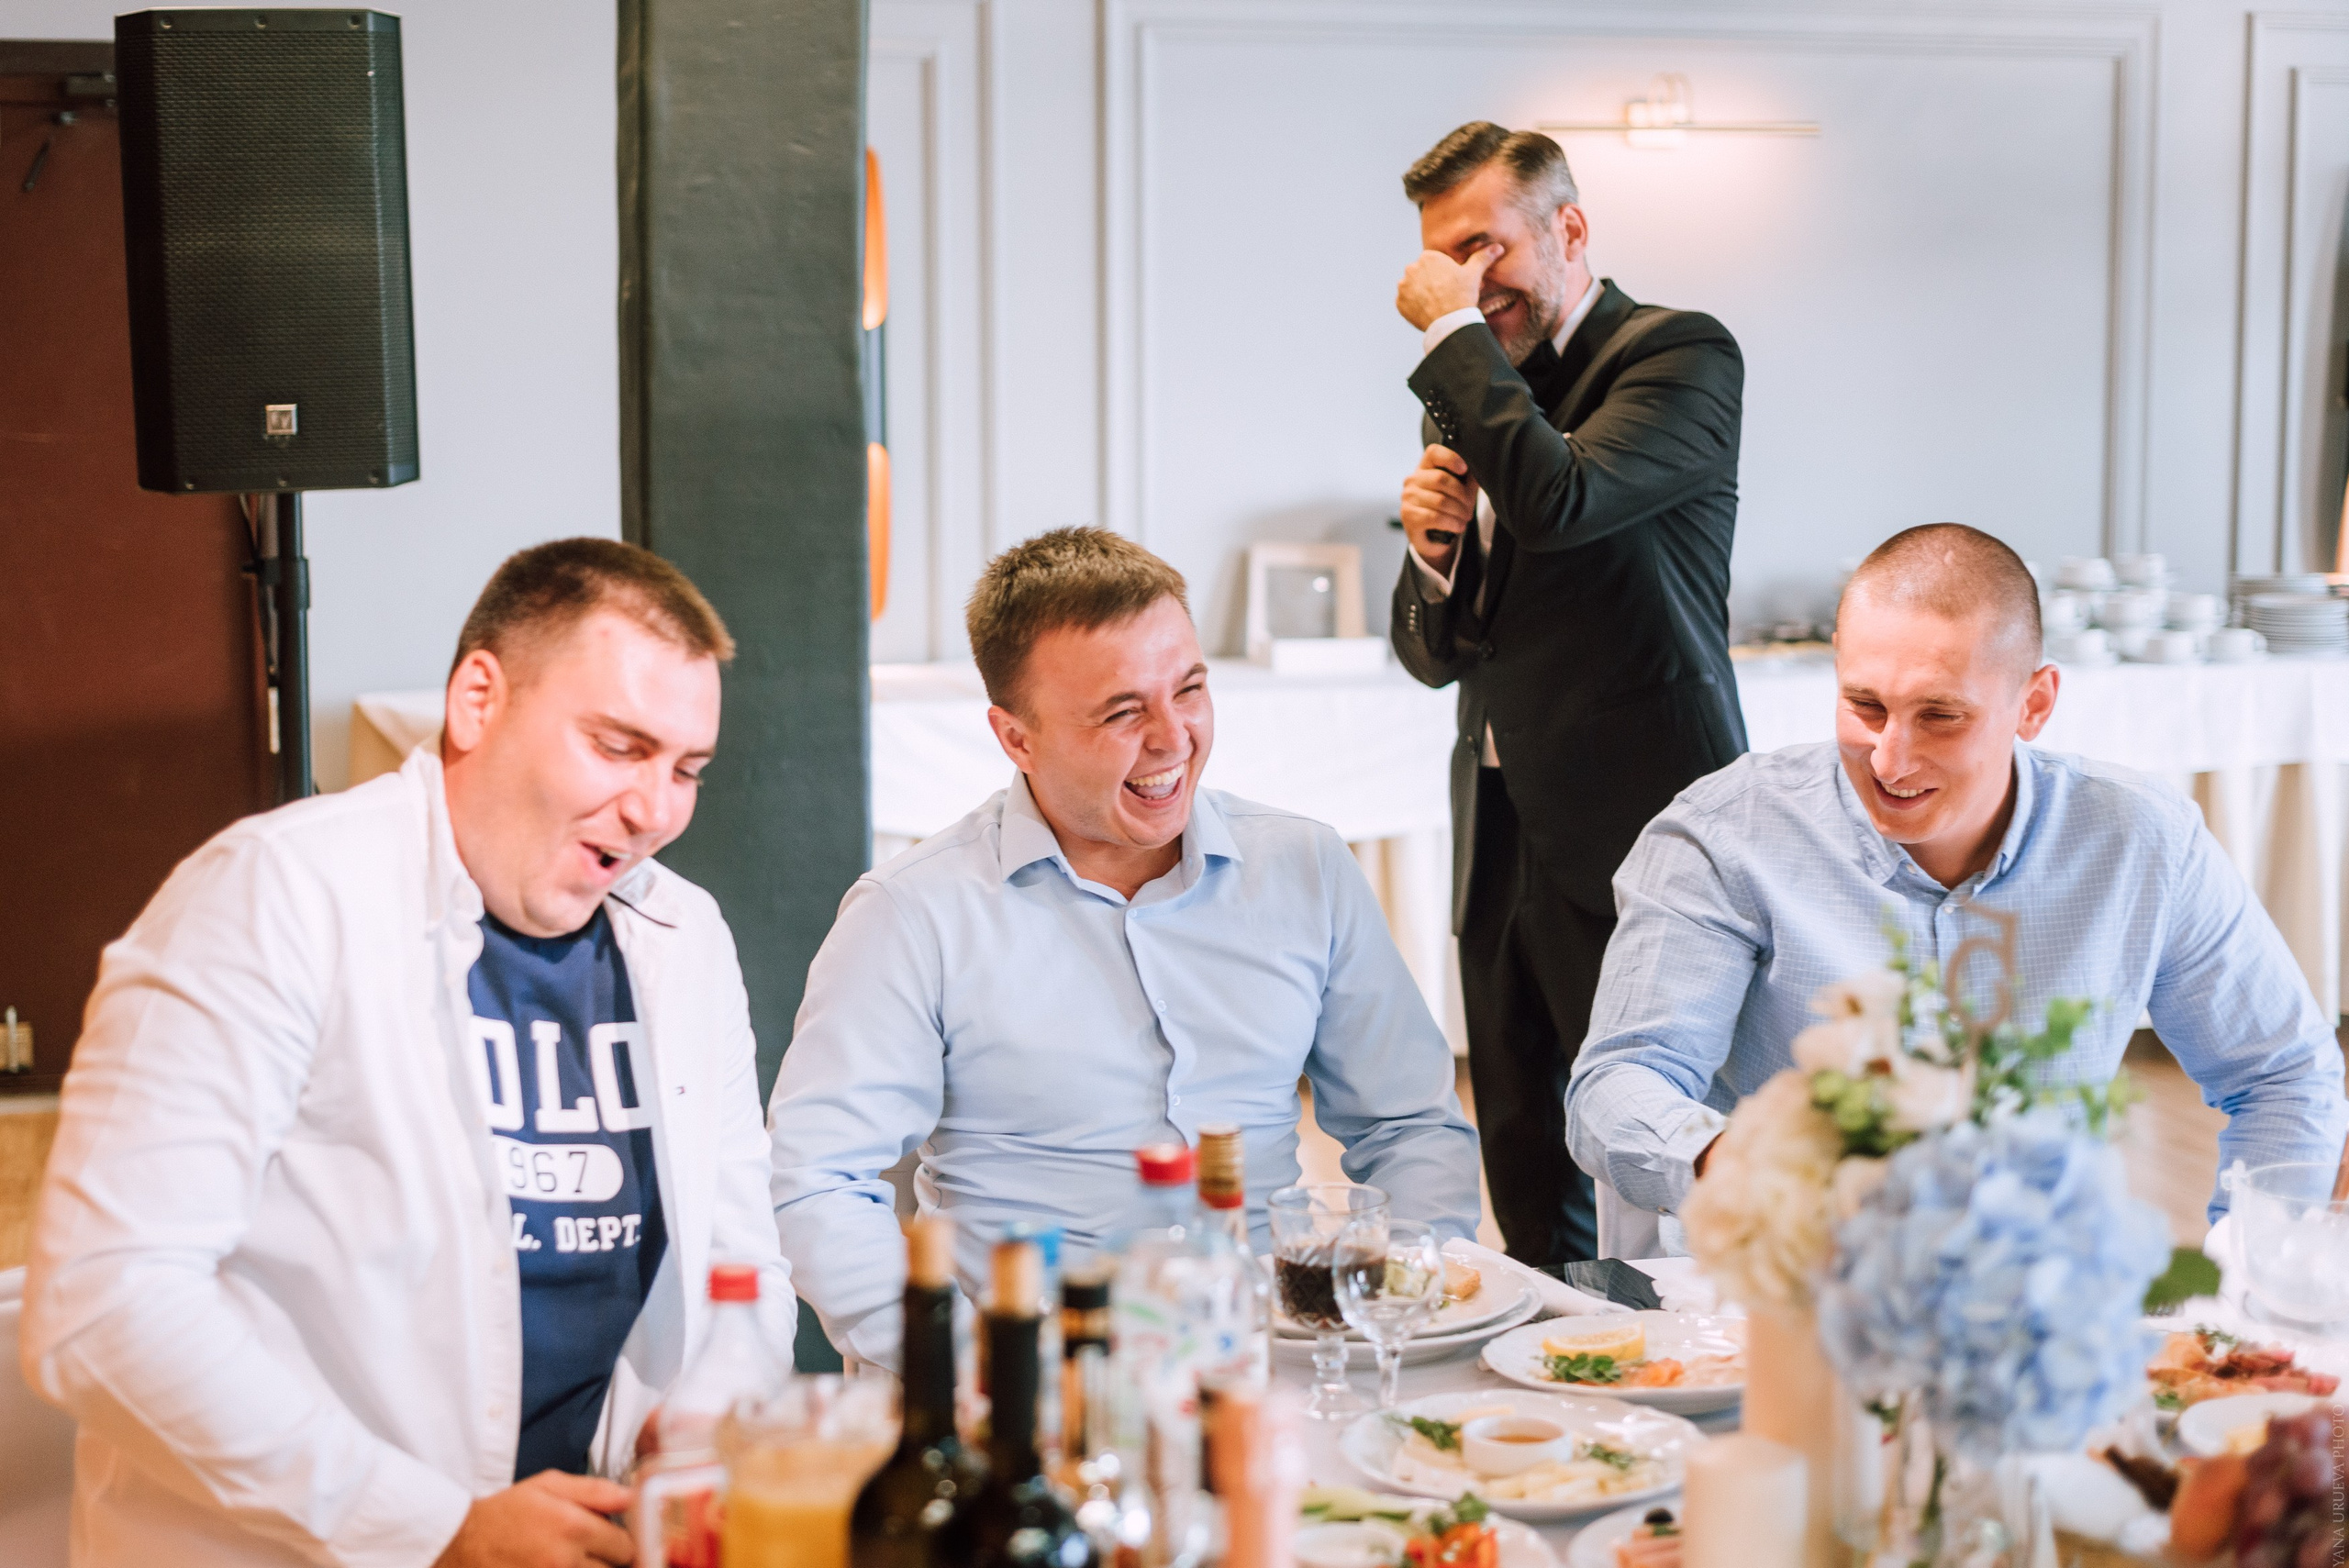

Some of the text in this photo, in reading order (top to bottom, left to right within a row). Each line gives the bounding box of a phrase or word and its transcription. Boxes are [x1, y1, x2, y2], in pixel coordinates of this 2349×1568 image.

[469, 1015, 653, 1132] OLO
[508, 1146, 588, 1193] 967
[512, 1212, 641, 1251] L. DEPT.
